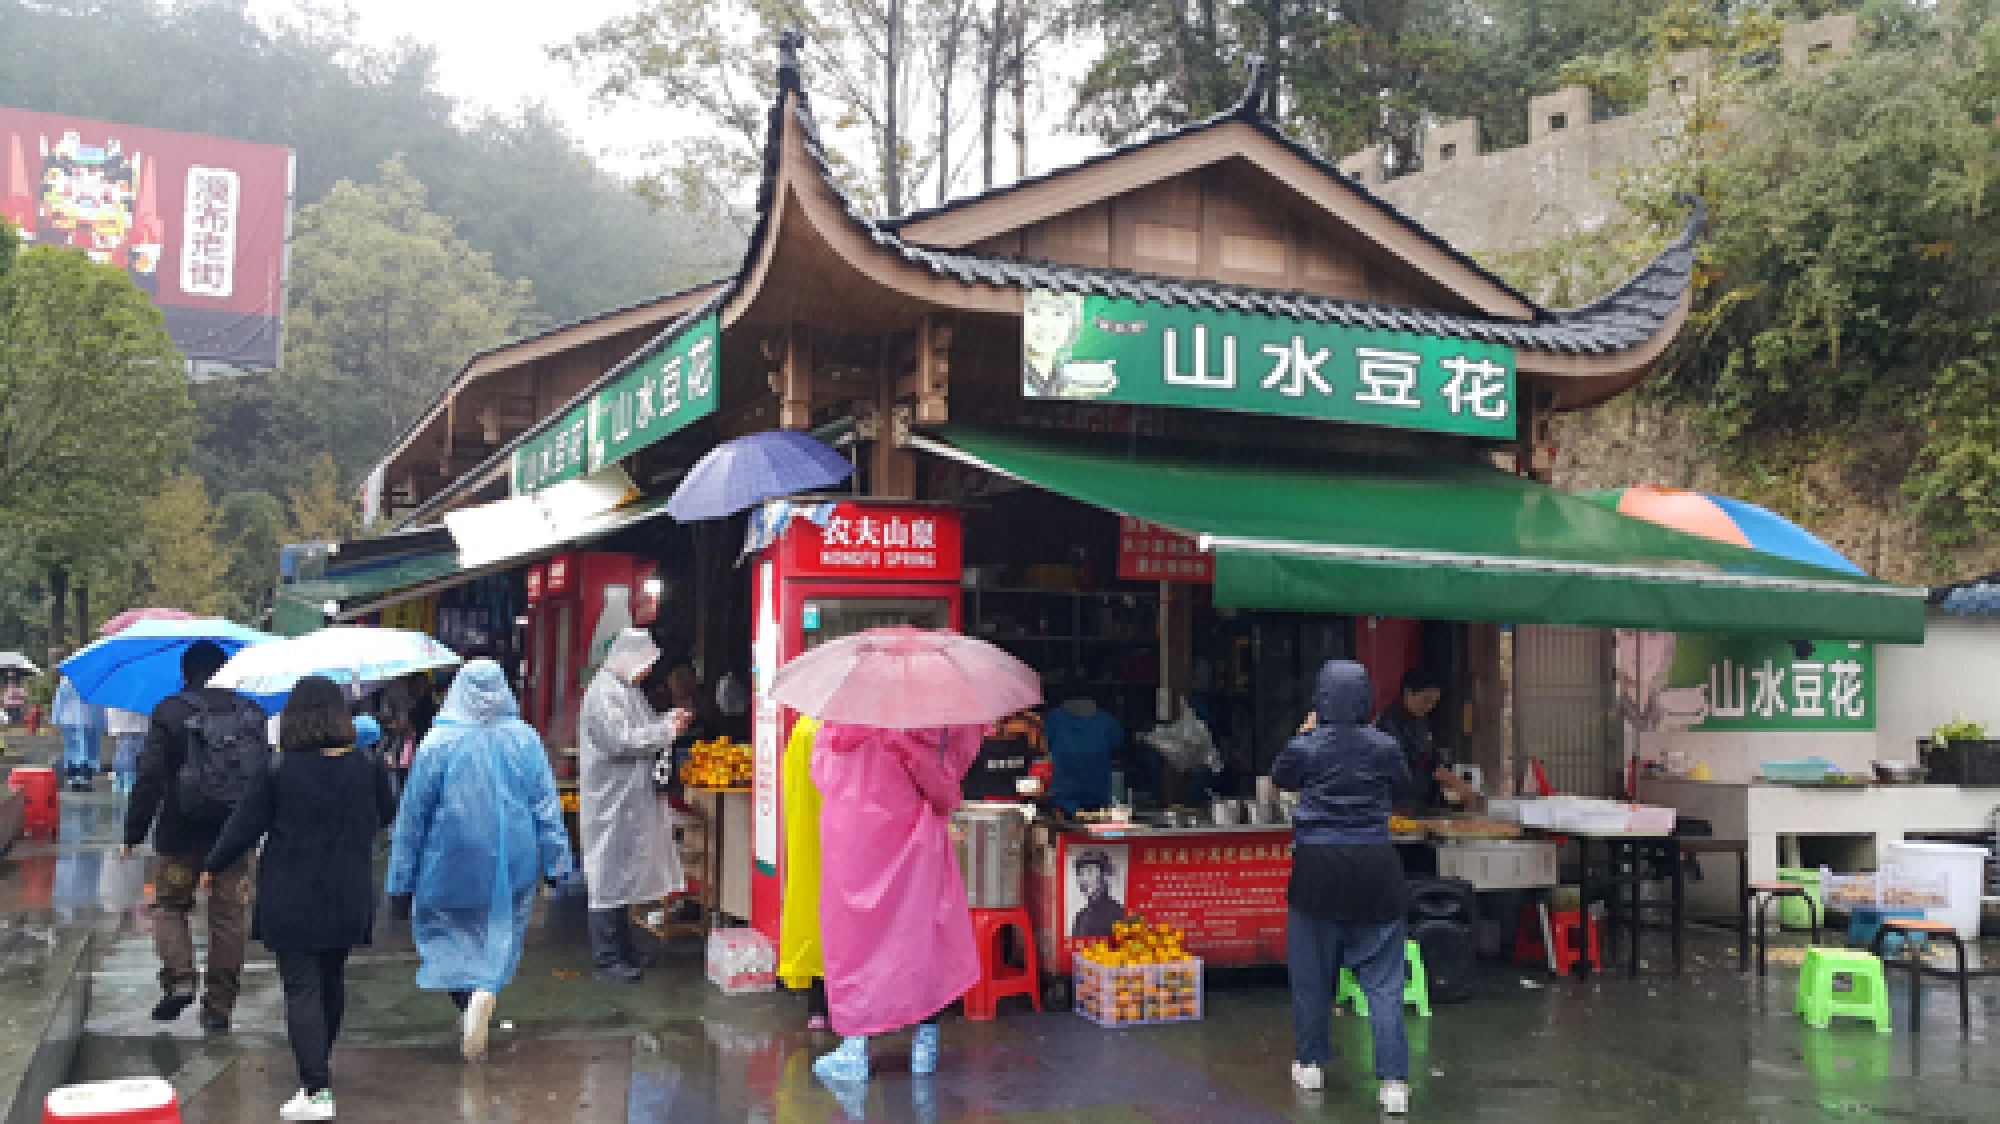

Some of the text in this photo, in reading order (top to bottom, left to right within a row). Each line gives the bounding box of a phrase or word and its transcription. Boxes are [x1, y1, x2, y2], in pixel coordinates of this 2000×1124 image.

[611, 335, 713, 444] 山水豆花
[1163, 324, 1509, 419] 山水豆花
[820, 515, 937, 549] 农夫山泉
[1710, 656, 1865, 719] 山水豆花
